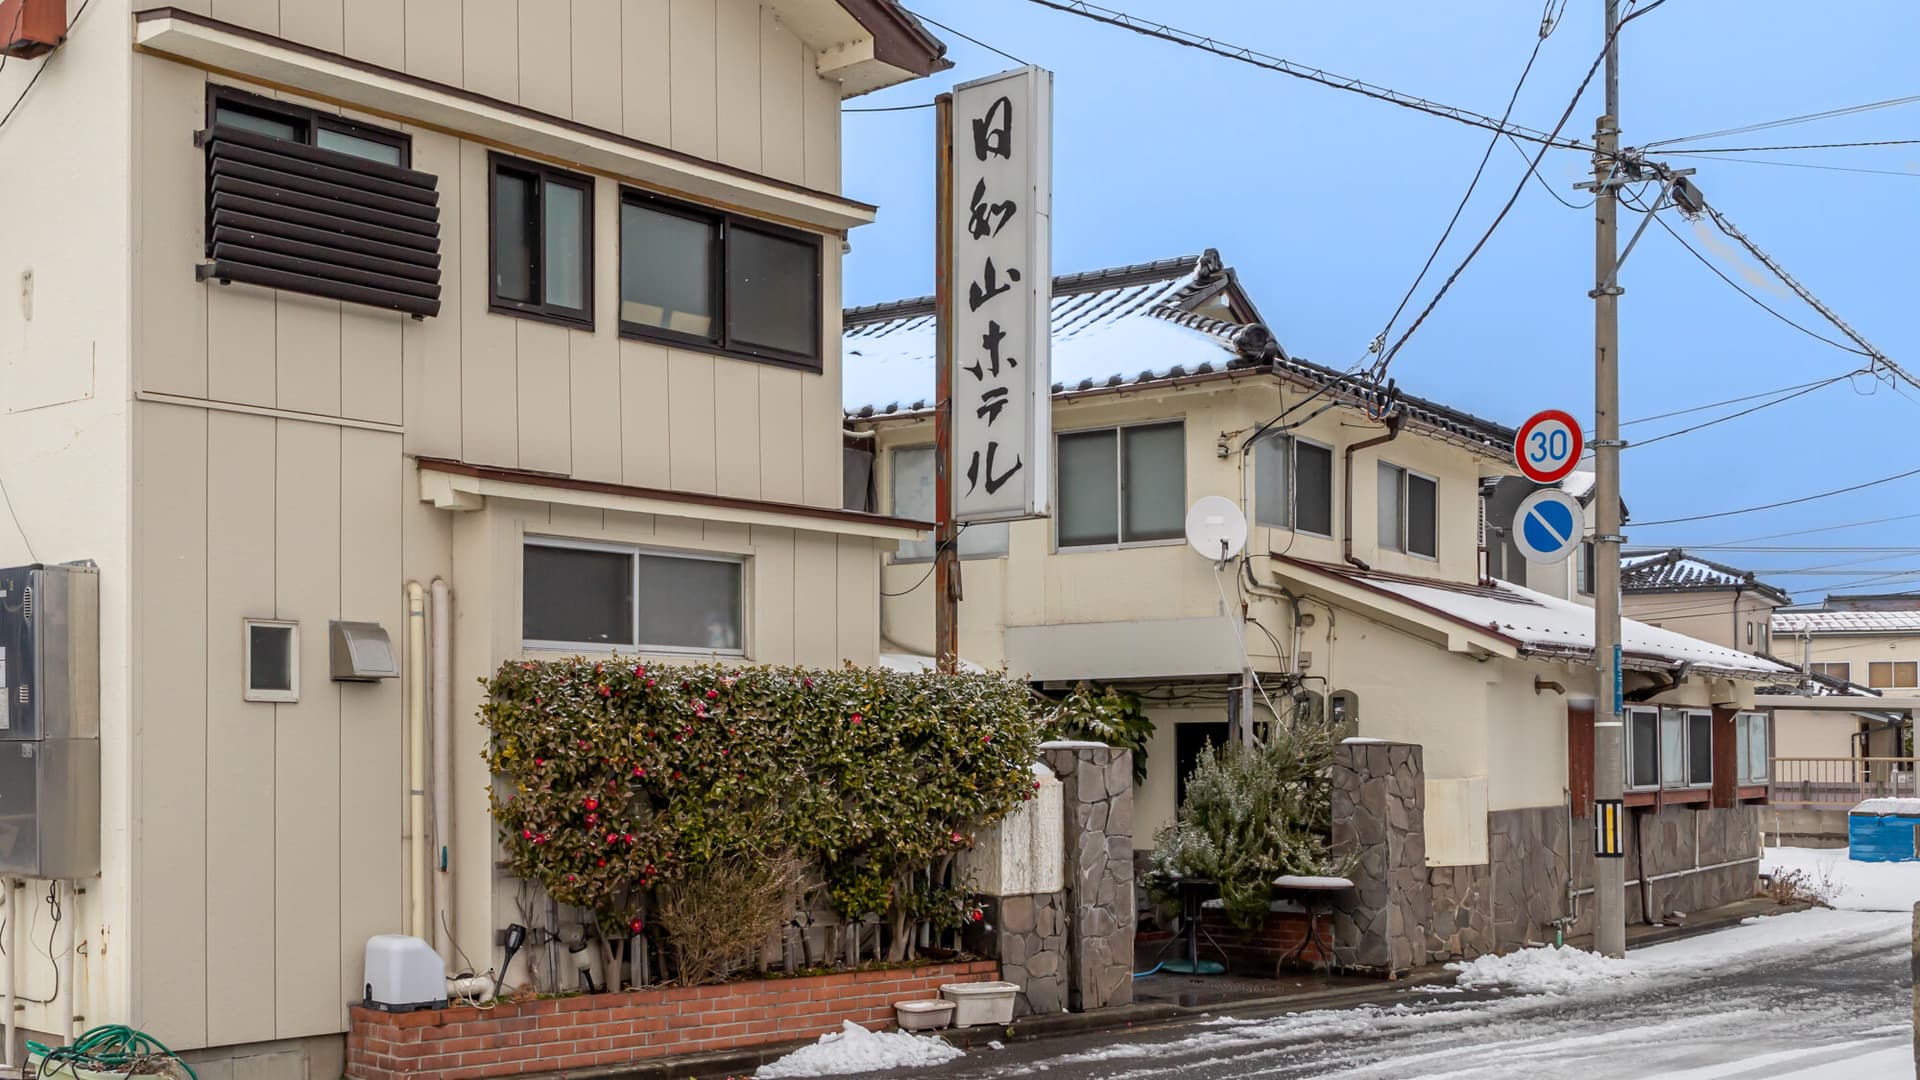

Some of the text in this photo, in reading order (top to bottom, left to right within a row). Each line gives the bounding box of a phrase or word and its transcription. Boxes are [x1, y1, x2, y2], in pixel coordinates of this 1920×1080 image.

[963, 96, 1023, 497] 日和山ホテル
[1530, 429, 1568, 463] 30
